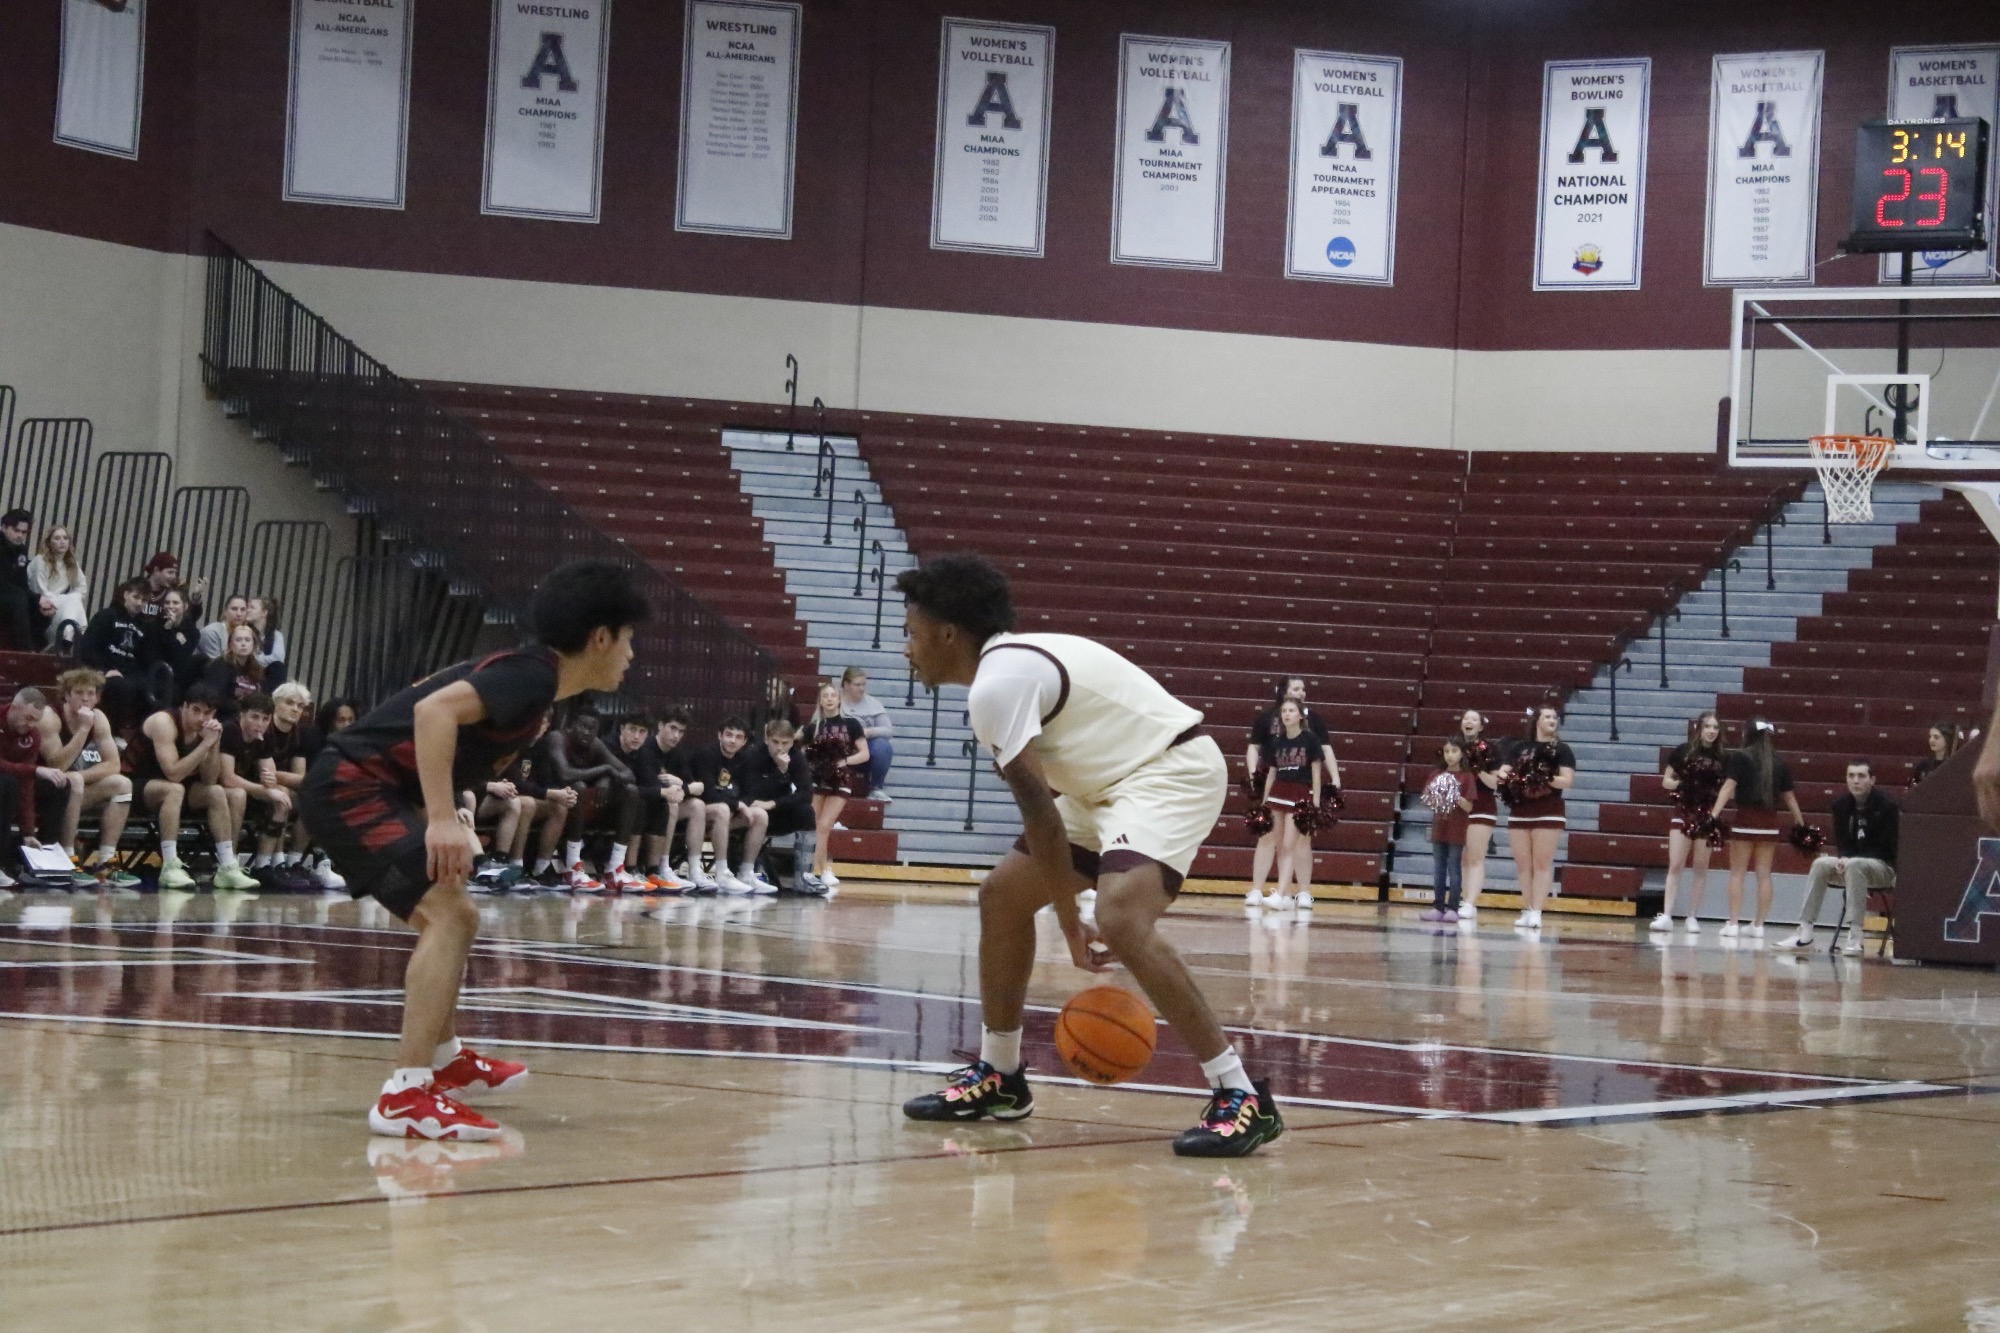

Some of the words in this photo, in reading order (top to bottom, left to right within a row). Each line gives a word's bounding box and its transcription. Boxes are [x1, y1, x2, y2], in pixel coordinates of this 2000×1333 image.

[338, 13, 366, 23] NCAA
[517, 3, 590, 20] WRESTLING
[315, 23, 388, 37] ALL-AMERICANS
[706, 20, 777, 35] WRESTLING
[728, 41, 755, 51] NCAA
[970, 36, 1027, 51] WOMEN'S
[520, 31, 579, 94] A
[706, 51, 776, 64] ALL-AMERICANS
[961, 51, 1035, 66] VOLLEYBALL
[1148, 53, 1204, 66] WOMEN'S
[1919, 59, 1977, 72] WOMEN'S
[1140, 67, 1212, 82] VOLLEYBALL
[1323, 68, 1377, 82] WOMEN'S
[1741, 67, 1797, 78] WOMEN'S
[1571, 75, 1625, 86] WOMEN'S
[1909, 74, 1986, 87] BASKETBALL
[1314, 82, 1384, 97] VOLLEYBALL
[1731, 82, 1805, 94] BASKETBALL
[536, 97, 561, 107] MIAA
[966, 70, 1023, 131] A
[1571, 90, 1624, 101] BOWLING
[518, 107, 577, 120] CHAMPIONS
[1145, 87, 1200, 146] A
[1887, 117, 1946, 126] DAKTRONICS
[1319, 102, 1374, 161] A
[1566, 107, 1620, 165] A
[1737, 101, 1792, 159] A
[980, 134, 1005, 144] MIAA
[963, 144, 1020, 157] CHAMPIONS
[1159, 149, 1183, 157] MIAA
[1139, 158, 1203, 170] TOURNAMENT
[1332, 164, 1357, 173] NCAA
[1751, 164, 1775, 172] MIAA
[1142, 170, 1198, 182] CHAMPIONS
[1313, 174, 1376, 186] TOURNAMENT
[1558, 175, 1626, 188] NATIONAL
[1735, 176, 1791, 185] CHAMPIONS
[1311, 185, 1376, 197] APPEARANCES
[1875, 167, 1948, 227] 23
[1554, 193, 1628, 205] CHAMPION
[1577, 213, 1602, 222] 2021
